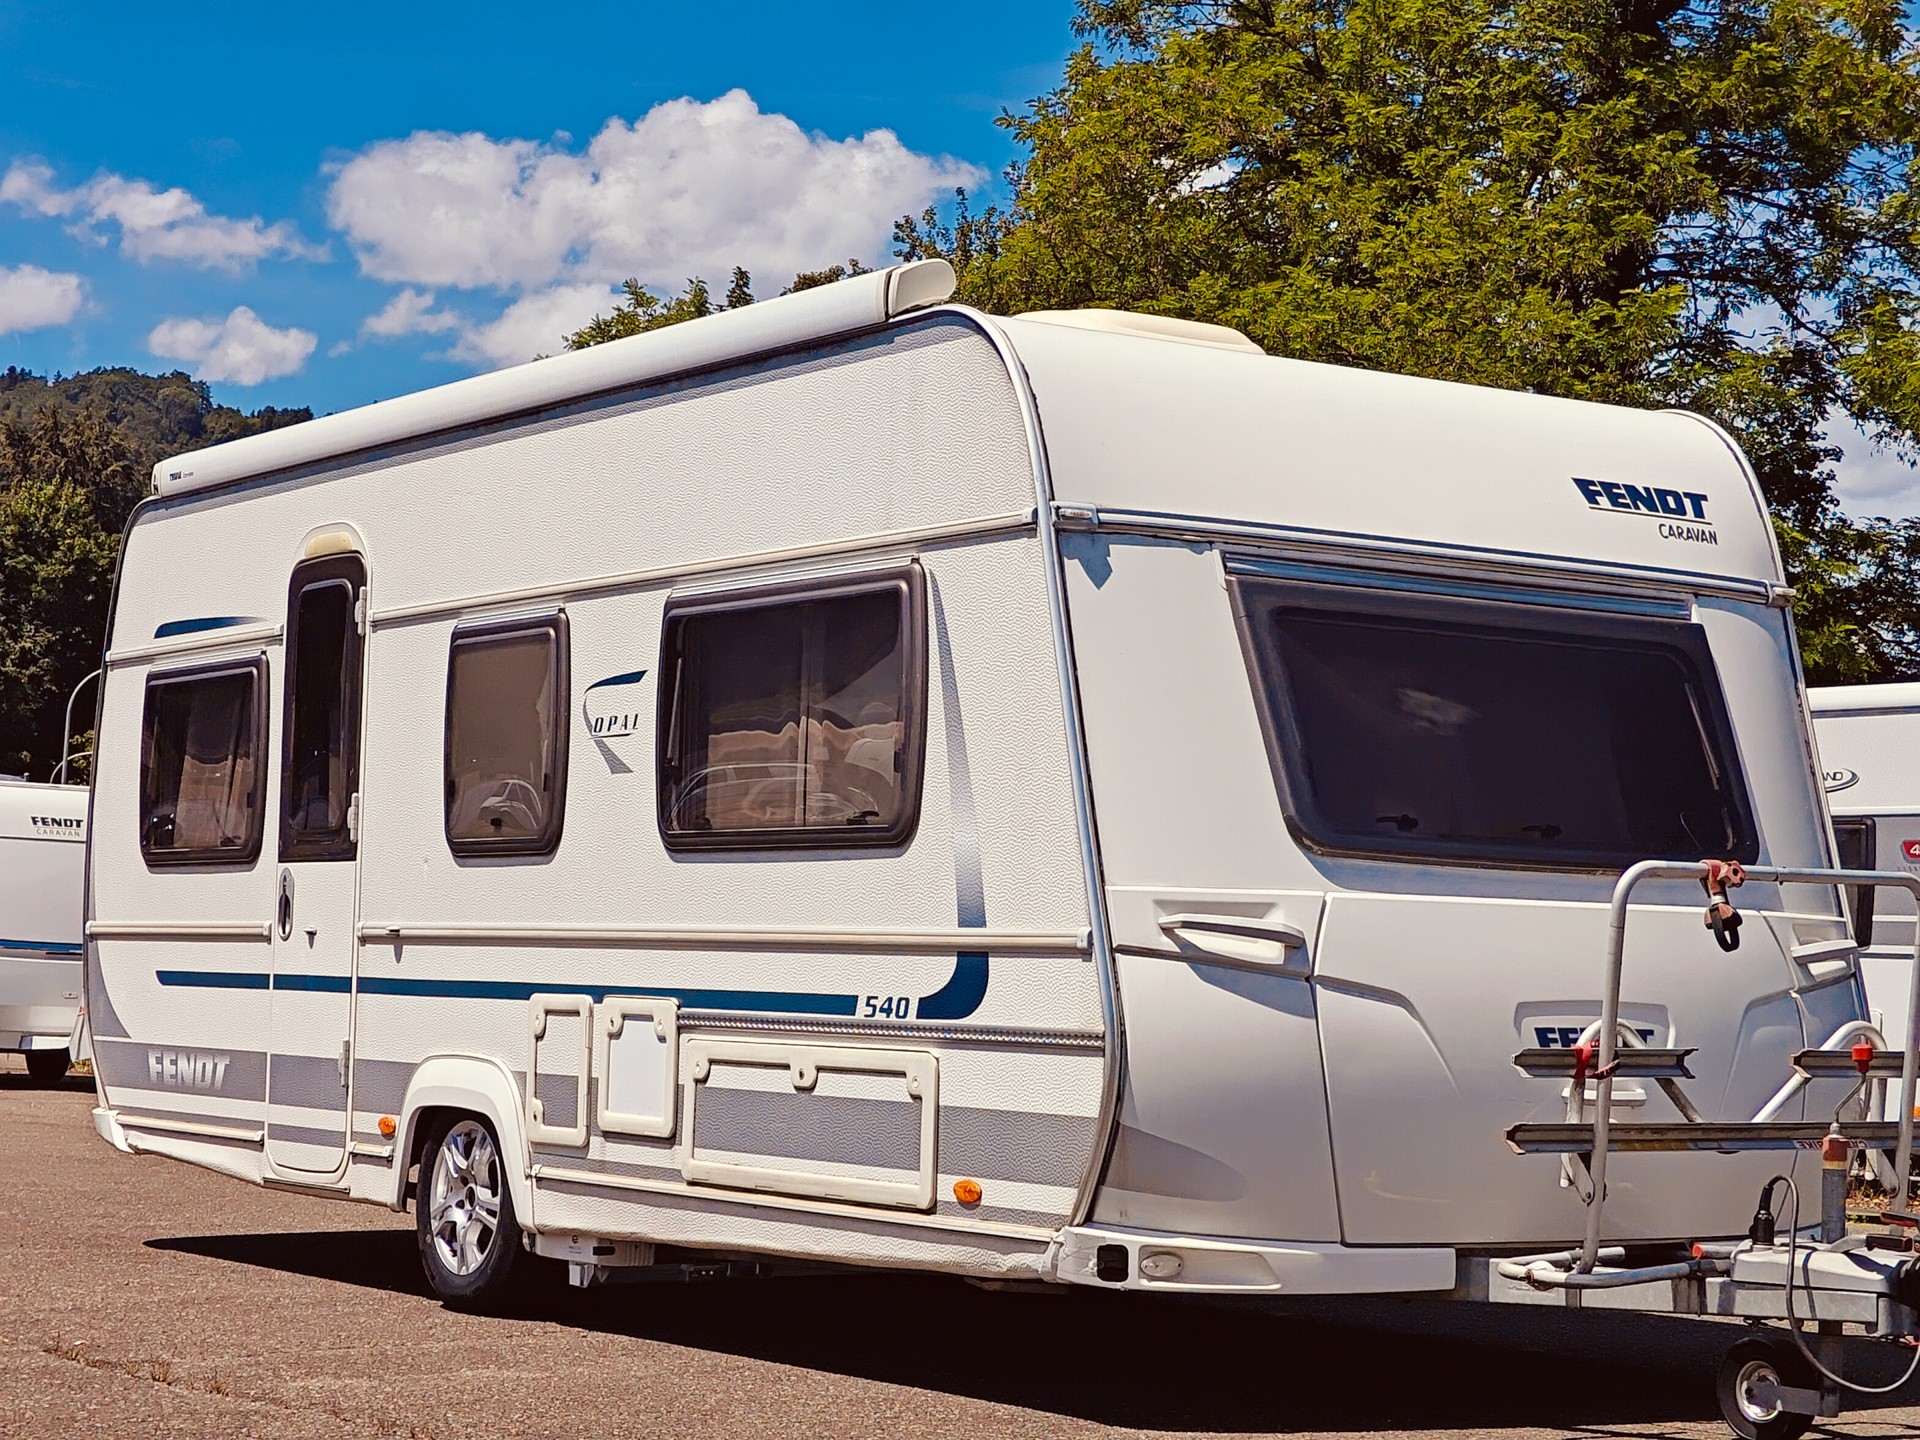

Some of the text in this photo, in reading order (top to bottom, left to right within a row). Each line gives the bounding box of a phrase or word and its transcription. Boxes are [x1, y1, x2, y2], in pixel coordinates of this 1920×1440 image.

[1571, 477, 1708, 520] FENDT
[1658, 523, 1718, 546] CARAVAN
[593, 713, 639, 733] OPAL
[30, 816, 84, 828] FENDT
[36, 828, 80, 837] CARAVAN
[864, 996, 910, 1019] 540
[1534, 1027, 1654, 1048] FET
[148, 1048, 230, 1090] FENDT
